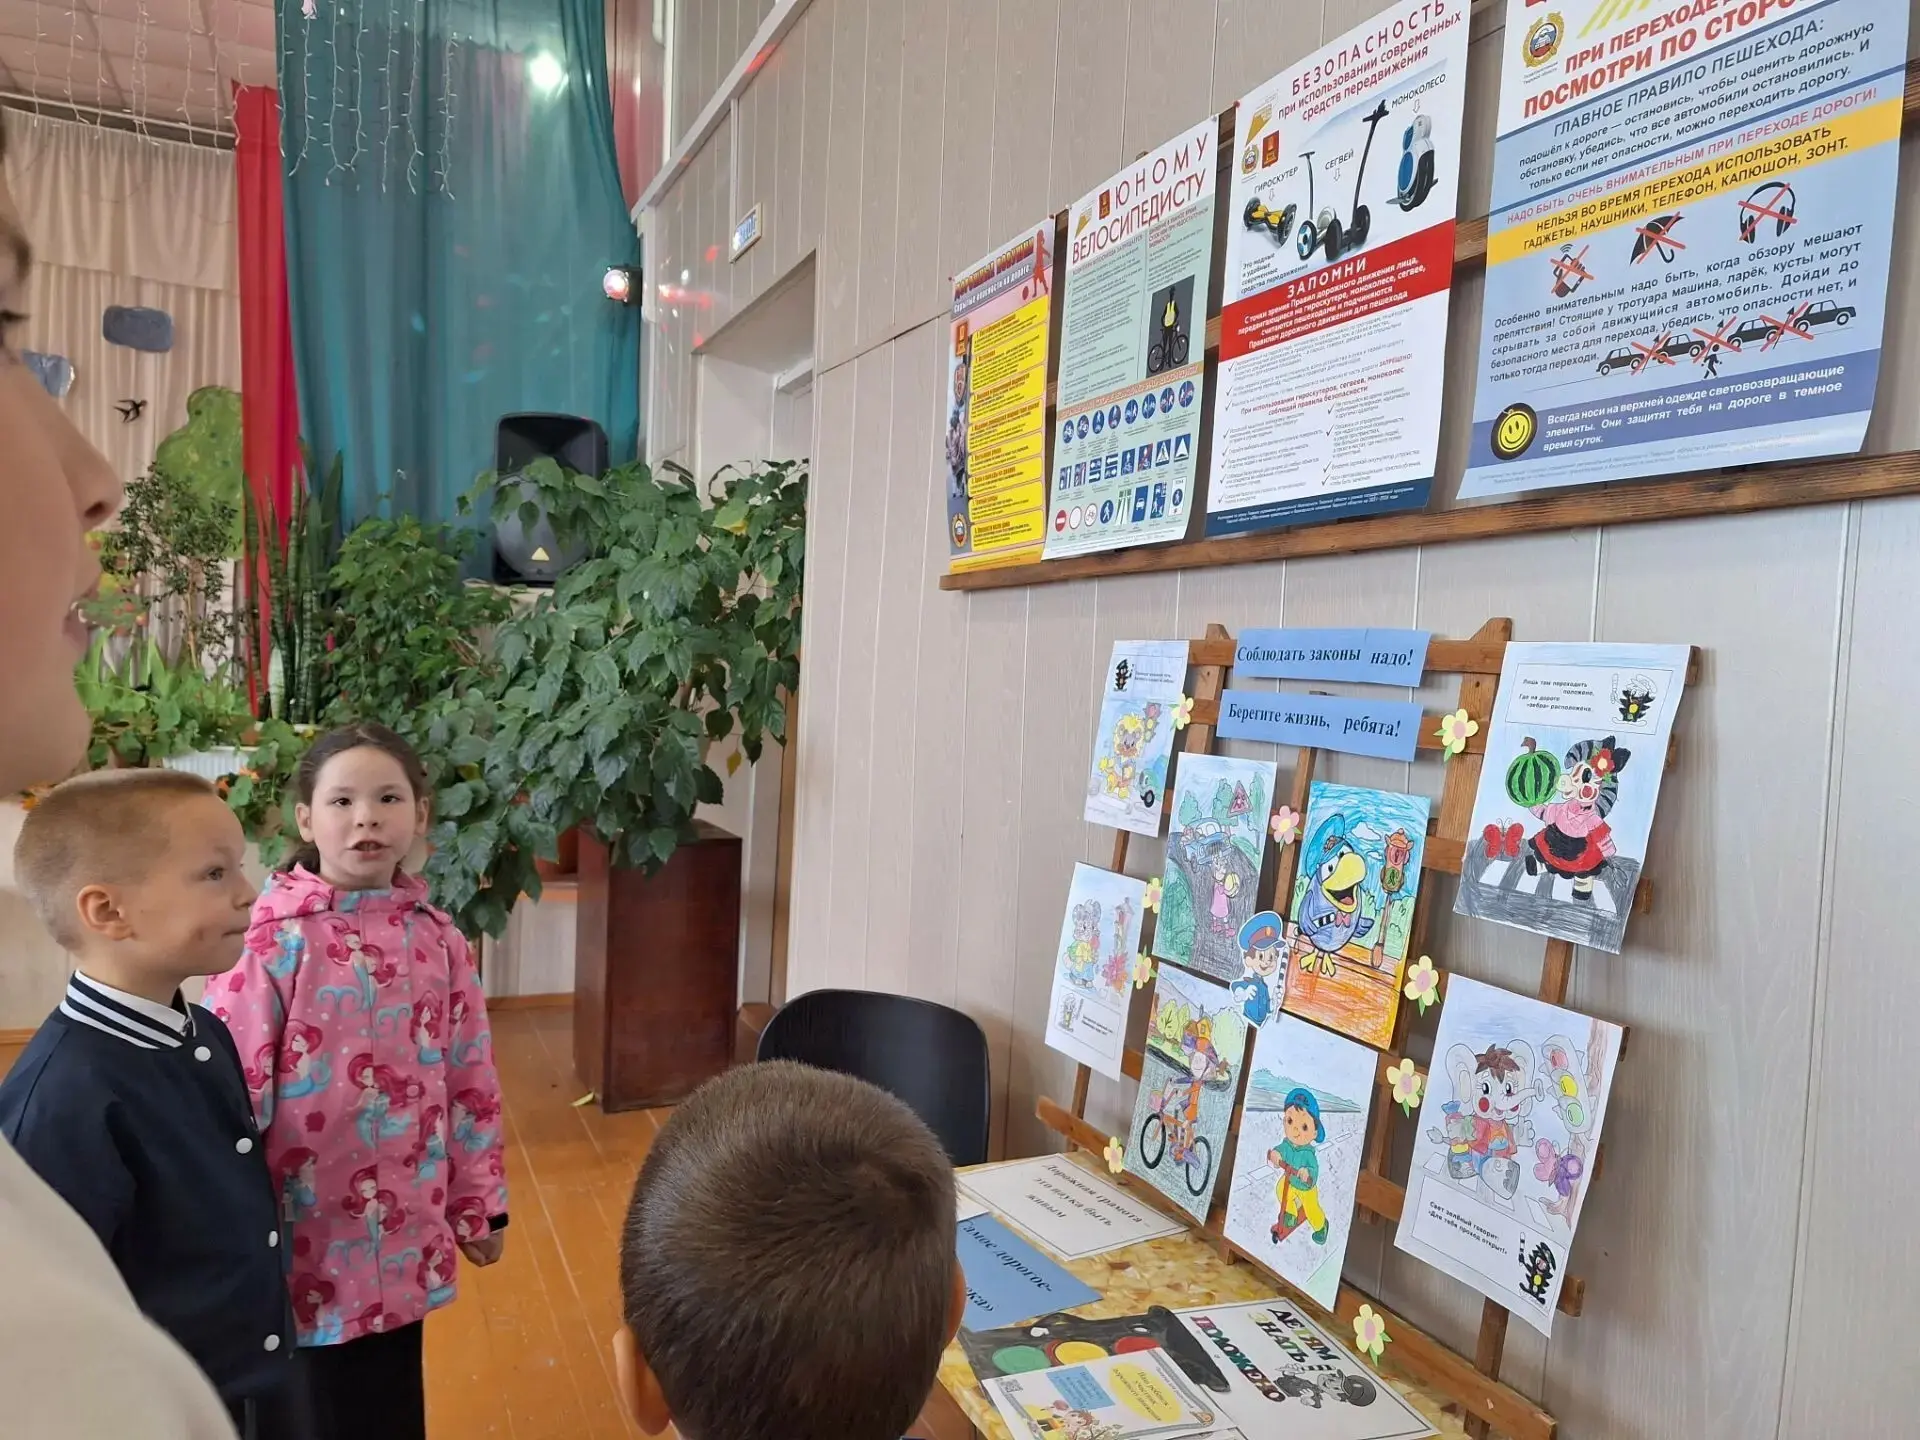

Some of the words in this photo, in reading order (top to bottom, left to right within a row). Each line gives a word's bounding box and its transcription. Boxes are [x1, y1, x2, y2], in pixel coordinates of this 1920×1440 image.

[1278, 101, 1295, 118] при
[1298, 56, 1377, 107] использовании
[1381, 10, 1461, 63] современных
[1292, 0, 1444, 96] БЕЗОПАСНОСТЬ
[1523, 44, 1652, 118] ПОСМОТРИ
[1660, 24, 1697, 60] ПО
[1554, 97, 1622, 137] ГЛАВНОЕ
[1627, 63, 1706, 107] ПРАВИЛО
[1711, 15, 1824, 74] ПЕШЕХОДА:
[1565, 41, 1603, 74] ПРИ
[1302, 92, 1340, 121] средств
[1344, 45, 1428, 99] передвижения
[1391, 73, 1445, 109] МОНОКОЛЕСО
[1519, 143, 1561, 166] подошёл
[1572, 125, 1608, 147] дороге
[1624, 93, 1693, 126] остановись,
[1698, 75, 1735, 97] чтобы
[1740, 52, 1794, 81] оценить
[1798, 21, 1873, 60] дорожную
[1519, 153, 1574, 179] обстановку,
[1578, 134, 1625, 160] убедись,
[1629, 125, 1647, 138] что
[1651, 116, 1670, 130] все
[1673, 86, 1748, 121] автомобили
[1752, 47, 1854, 92] остановились.
[1325, 148, 1353, 170] СЕГВЕЙ
[1507, 207, 1533, 223] НАДО
[1536, 196, 1564, 214] БЫТЬ
[1567, 183, 1602, 203] ОЧЕНЬ
[1606, 147, 1704, 189] ВНИМАТЕЛЬНЫМ
[1707, 137, 1732, 155] ПРИ
[1737, 111, 1808, 145] ПЕРЕХОДЕ
[1812, 87, 1876, 120] ДОРОГИ!
[1528, 172, 1561, 190] только
[1564, 162, 1588, 177] если
[1591, 154, 1608, 167] нет
[1611, 132, 1671, 160] опасности,
[1676, 115, 1715, 136] можно
[1719, 85, 1794, 120] переходить
[1798, 66, 1850, 93] дорогу.
[1115, 132, 1208, 209] ЮНОМУ
[1254, 165, 1298, 194] ГИРОСКУТЕР
[1523, 225, 1576, 250] ГАДЖЕТЫ,
[1580, 202, 1647, 232] НАУШНИКИ,
[1651, 180, 1716, 209] ТЕЛЕФОН,
[1721, 153, 1800, 187] КАПЮШОН,
[1806, 138, 1847, 160] ЗОНТ.
[1536, 209, 1578, 232] НЕЛЬЗЯ
[1581, 203, 1596, 217] ВО
[1599, 188, 1640, 211] ВРЕМЯ
[1644, 165, 1711, 196] ПЕРЕХОДА
[1715, 124, 1831, 173] ИСПОЛЬЗОВАТЬ
[1072, 168, 1206, 264] ВЕЛОСИПЕДИСТУ
[1287, 257, 1366, 298] ЗАПОМНИ
[1492, 337, 1539, 354] скрывать
[1545, 333, 1556, 341] за
[1562, 322, 1595, 337] собой
[1601, 304, 1678, 330] движущийся
[1686, 282, 1771, 308] автомобиль.
[1781, 268, 1829, 287] Дойди
[1839, 260, 1858, 274] до
[1493, 318, 1555, 342] препятствия!
[1558, 307, 1603, 325] Стоящие
[1618, 291, 1667, 311] тротуара
[1671, 278, 1722, 297] машина,
[1727, 266, 1767, 283] ларёк,
[1773, 254, 1813, 272] кусты
[1819, 242, 1860, 260] могут
[1495, 310, 1540, 327] Особенно
[1546, 287, 1624, 314] внимательным
[1631, 279, 1657, 292] надо
[1665, 269, 1698, 283] быть,
[1706, 257, 1739, 272] когда
[1748, 243, 1794, 262] обзору
[1803, 225, 1862, 247] мешают
[1490, 349, 1548, 368] безопасного
[1551, 342, 1579, 355] места
[1582, 337, 1601, 349] для
[1604, 325, 1658, 342] перехода,
[1661, 312, 1713, 332] убедись,
[1718, 305, 1739, 317] что
[1743, 288, 1812, 311] опасности
[1817, 282, 1843, 294] нет,
[1489, 369, 1520, 382] только
[1522, 363, 1547, 375] тогда
[1549, 352, 1598, 369] переходи.
[1547, 412, 1580, 424] Всегда
[1581, 407, 1605, 418] носи
[1606, 405, 1619, 414] на
[1620, 395, 1663, 412] верхней
[1665, 389, 1706, 405] одежде
[1709, 365, 1844, 397] световозвращающие
[1543, 439, 1572, 451] время
[1574, 435, 1602, 447] суток.
[1545, 423, 1594, 437] элементы.
[1601, 418, 1621, 428] Они
[1627, 410, 1670, 424] защитят
[1676, 404, 1701, 416] тебя
[1709, 401, 1722, 411] на
[1728, 393, 1771, 409] дороге
[1237, 646, 1305, 663] Соблюдать
[1309, 648, 1360, 661] законы
[1370, 648, 1413, 667] надо!
[1228, 704, 1280, 723] Берегите
[1284, 712, 1330, 729] жизнь,
[1343, 715, 1400, 737] ребята!
[1025, 1193, 1067, 1218] живым
[1033, 1177, 1052, 1189] это
[1051, 1186, 1085, 1208] наука
[1083, 1205, 1112, 1226] быть
[1043, 1164, 1096, 1195] Дорожная
[1097, 1194, 1143, 1223] грамота
[1429, 1201, 1445, 1213] Свет
[1444, 1218, 1458, 1228] тебя
[1460, 1225, 1481, 1241] проход
[1190, 1315, 1286, 1402] ПОЛОЖЕНО
[1248, 1312, 1309, 1363] ЗНАТЬ
[1266, 1309, 1341, 1361] ДЕТЯМ
